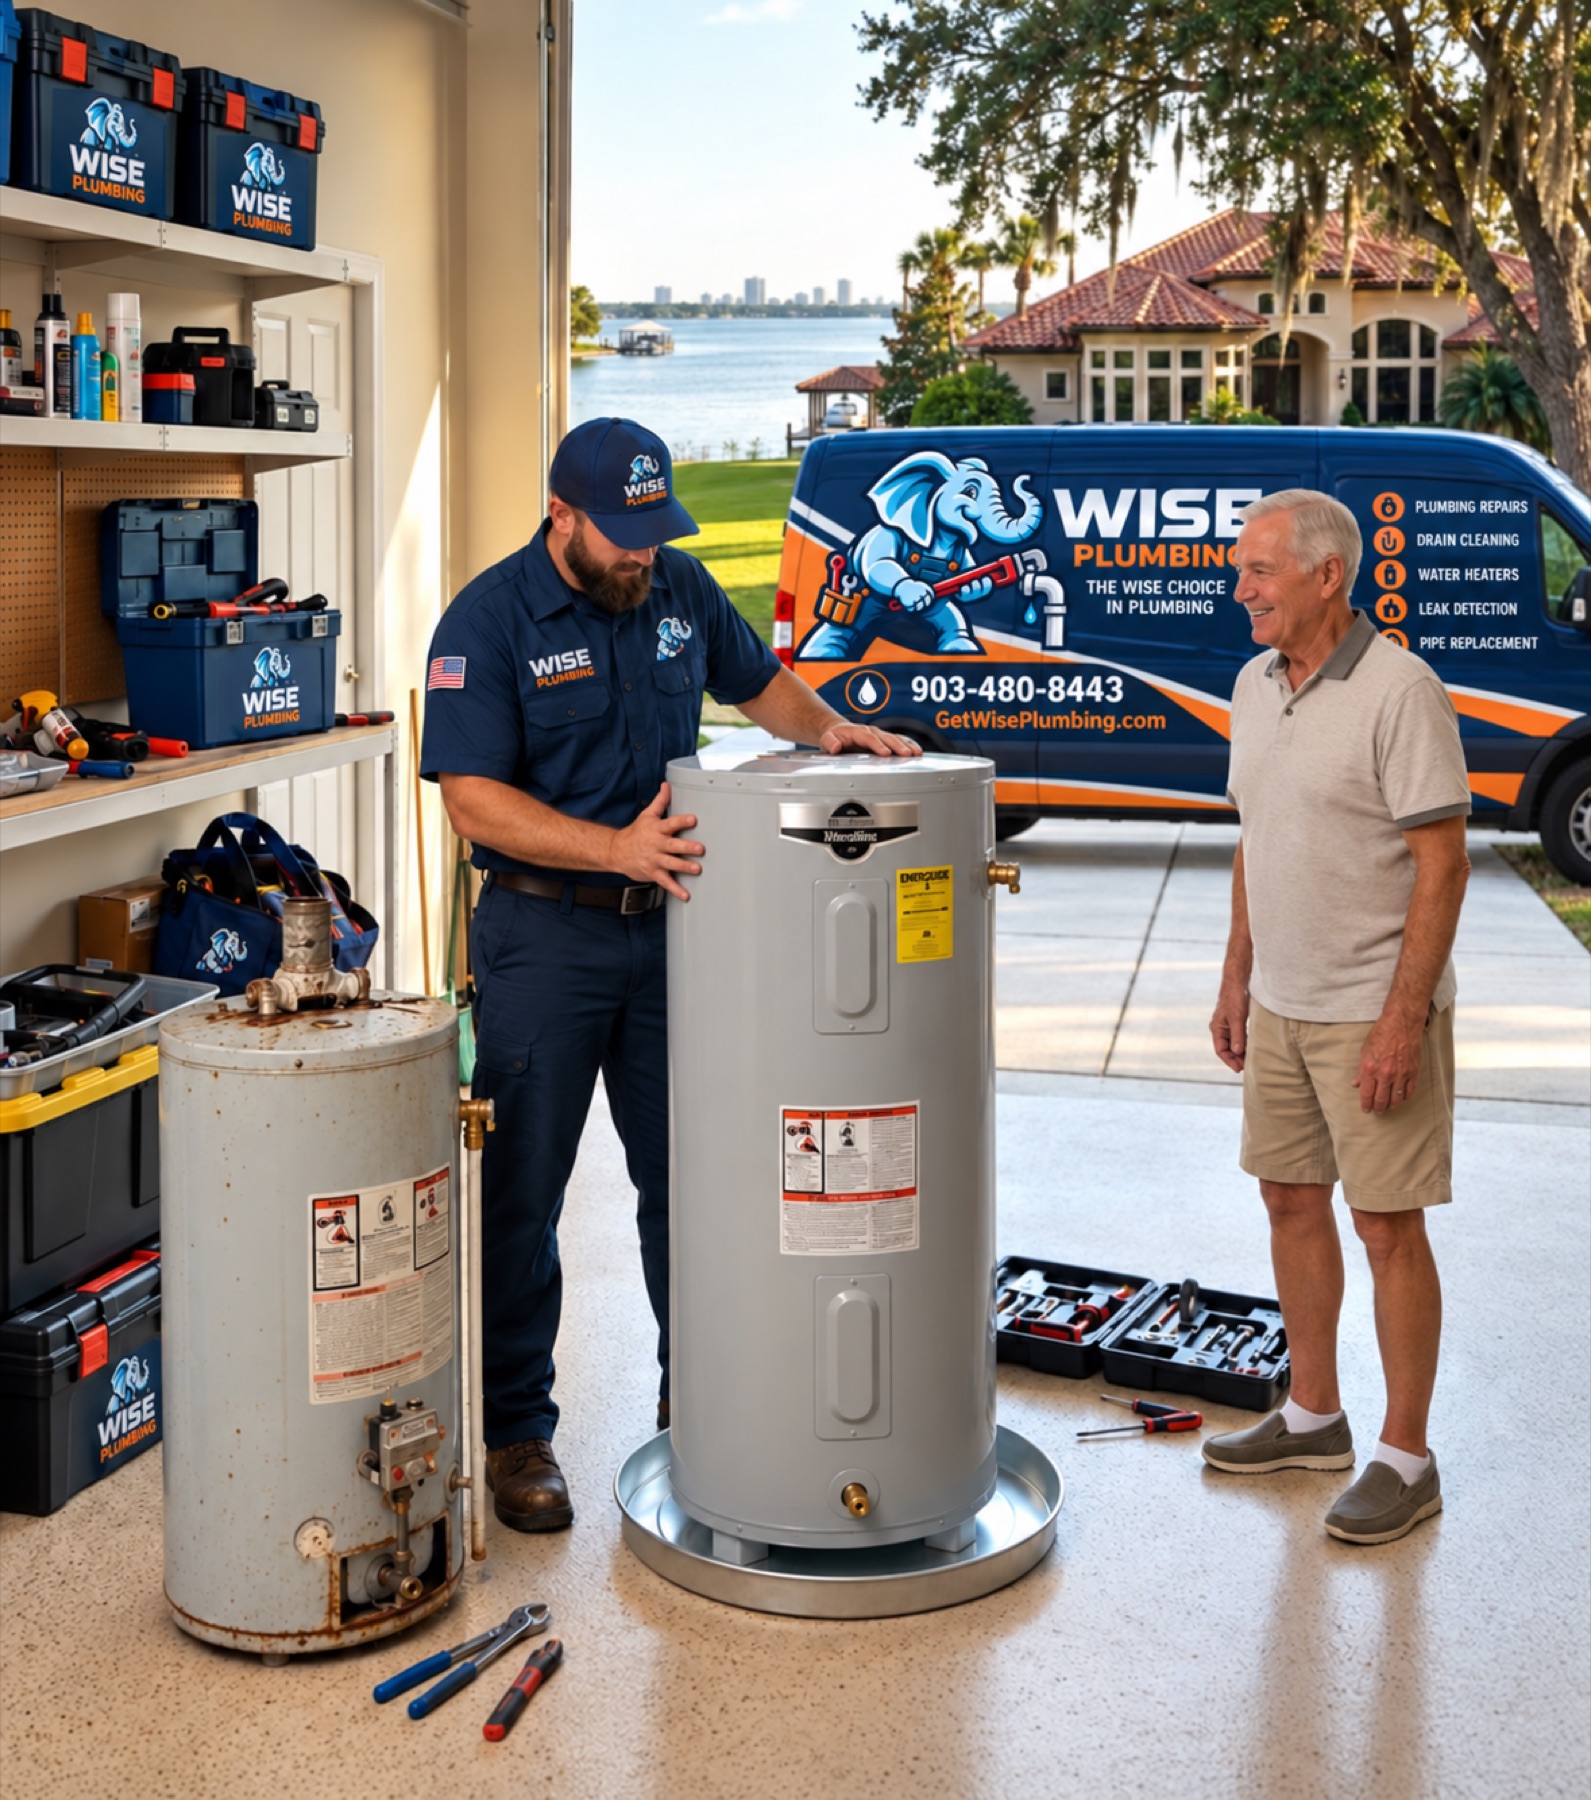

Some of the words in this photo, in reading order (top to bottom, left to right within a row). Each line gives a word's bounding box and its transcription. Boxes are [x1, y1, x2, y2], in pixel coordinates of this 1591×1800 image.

[69, 144, 145, 187] WISE
[72, 174, 146, 204] PLUMBING
[231, 185, 292, 222] WISE
[233, 211, 292, 237] PLUMBING
[623, 476, 666, 498] WISE
[1053, 488, 1262, 538] WISE
[1415, 501, 1475, 513] PLUMBING
[1480, 501, 1528, 513] REPAIRS
[1417, 533, 1456, 546] DRAIN
[1460, 533, 1519, 546] CLEANING
[1418, 568, 1460, 580] WATER
[1465, 568, 1519, 580] HEATERS
[1086, 579, 1116, 595] THE
[1121, 579, 1163, 595] WISE
[1168, 579, 1226, 595] CHOICE
[1107, 599, 1123, 615] IN
[1128, 599, 1214, 615] PLUMBING
[1419, 603, 1449, 615] LEAK
[1454, 602, 1517, 615] DETECTION
[1420, 637, 1445, 649] PIPE
[1450, 637, 1538, 649] REPLACEMENT
[528, 648, 592, 677] WISE
[536, 666, 595, 688] PLUMBING
[911, 676, 1124, 703] 903-480-8443
[242, 686, 299, 715] WISE
[935, 710, 1167, 734] GetWisePlumbing.com
[97, 1392, 156, 1446] WISE
[100, 1418, 157, 1464] PLUMBING
